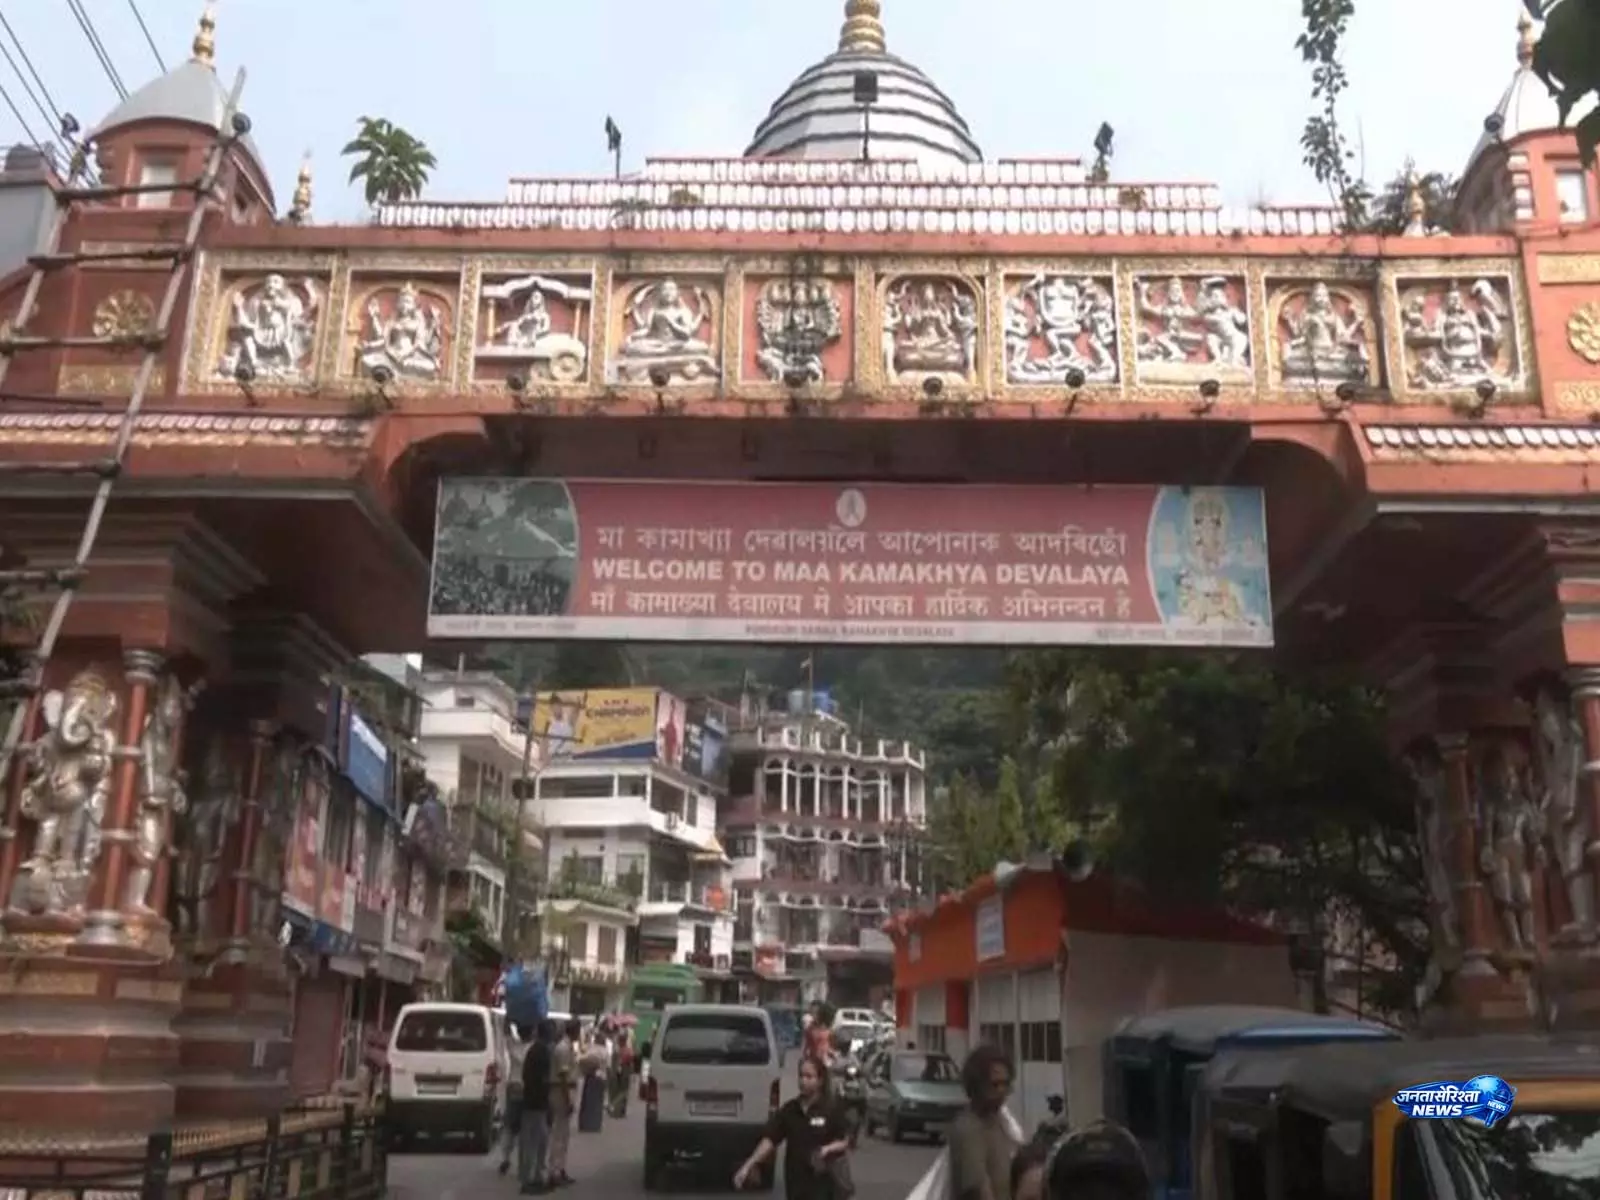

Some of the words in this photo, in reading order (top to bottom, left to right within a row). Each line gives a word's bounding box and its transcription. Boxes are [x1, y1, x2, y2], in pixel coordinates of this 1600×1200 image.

[596, 527, 624, 551] মা
[635, 527, 732, 552] কামাখ্যা
[877, 530, 1001, 555] আপোনাক
[592, 558, 724, 581] WELCOME
[731, 560, 766, 582] TO
[774, 560, 830, 583] MAA
[839, 562, 988, 585] KAMAKHYA
[996, 563, 1130, 585] DEVALAYA
[625, 591, 718, 614] कामाख्या
[726, 585, 804, 616] देवालय
[843, 593, 915, 617] आपका
[924, 587, 992, 617] हार्दिक
[1001, 587, 1105, 618] अभिनन्दन
